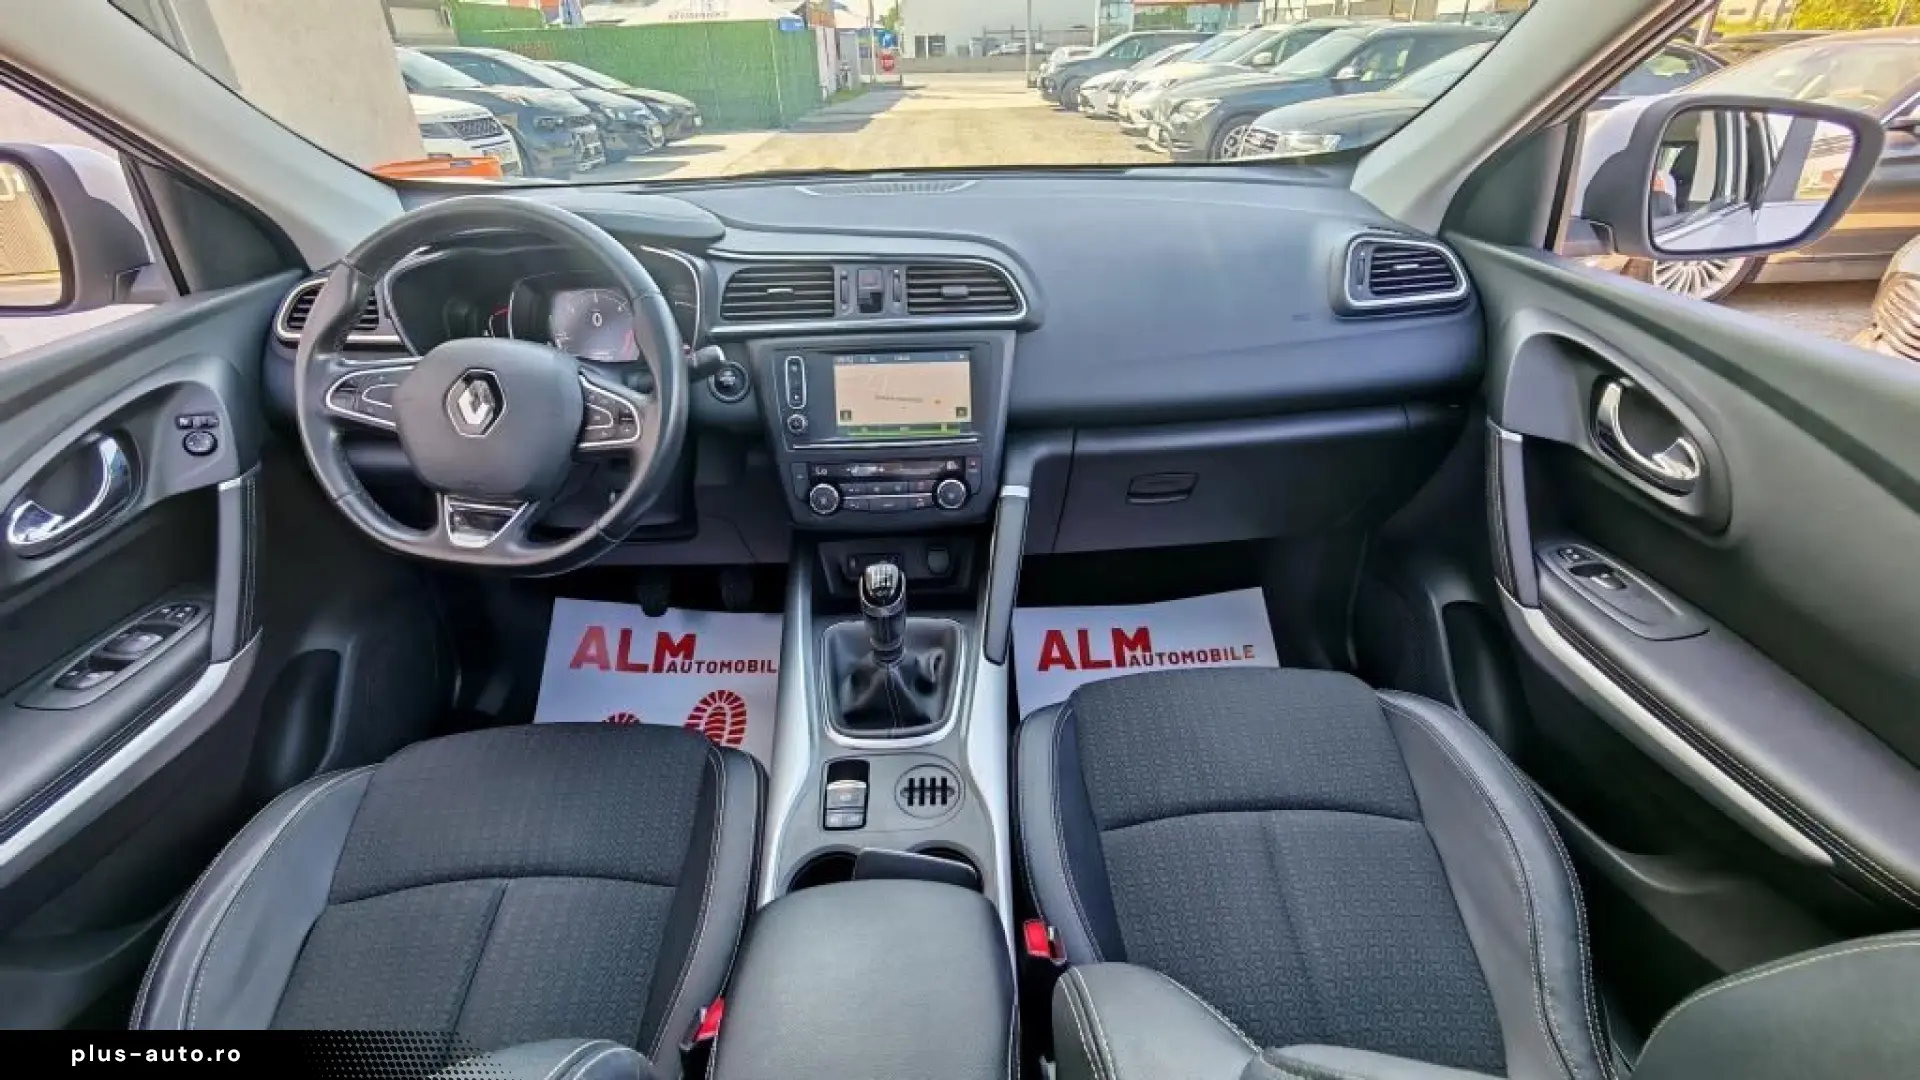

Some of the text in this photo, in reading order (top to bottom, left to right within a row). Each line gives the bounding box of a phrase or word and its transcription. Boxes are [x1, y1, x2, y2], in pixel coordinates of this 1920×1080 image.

[570, 625, 697, 674] ALM
[1038, 626, 1255, 672] ALM AUTOMOBILE
